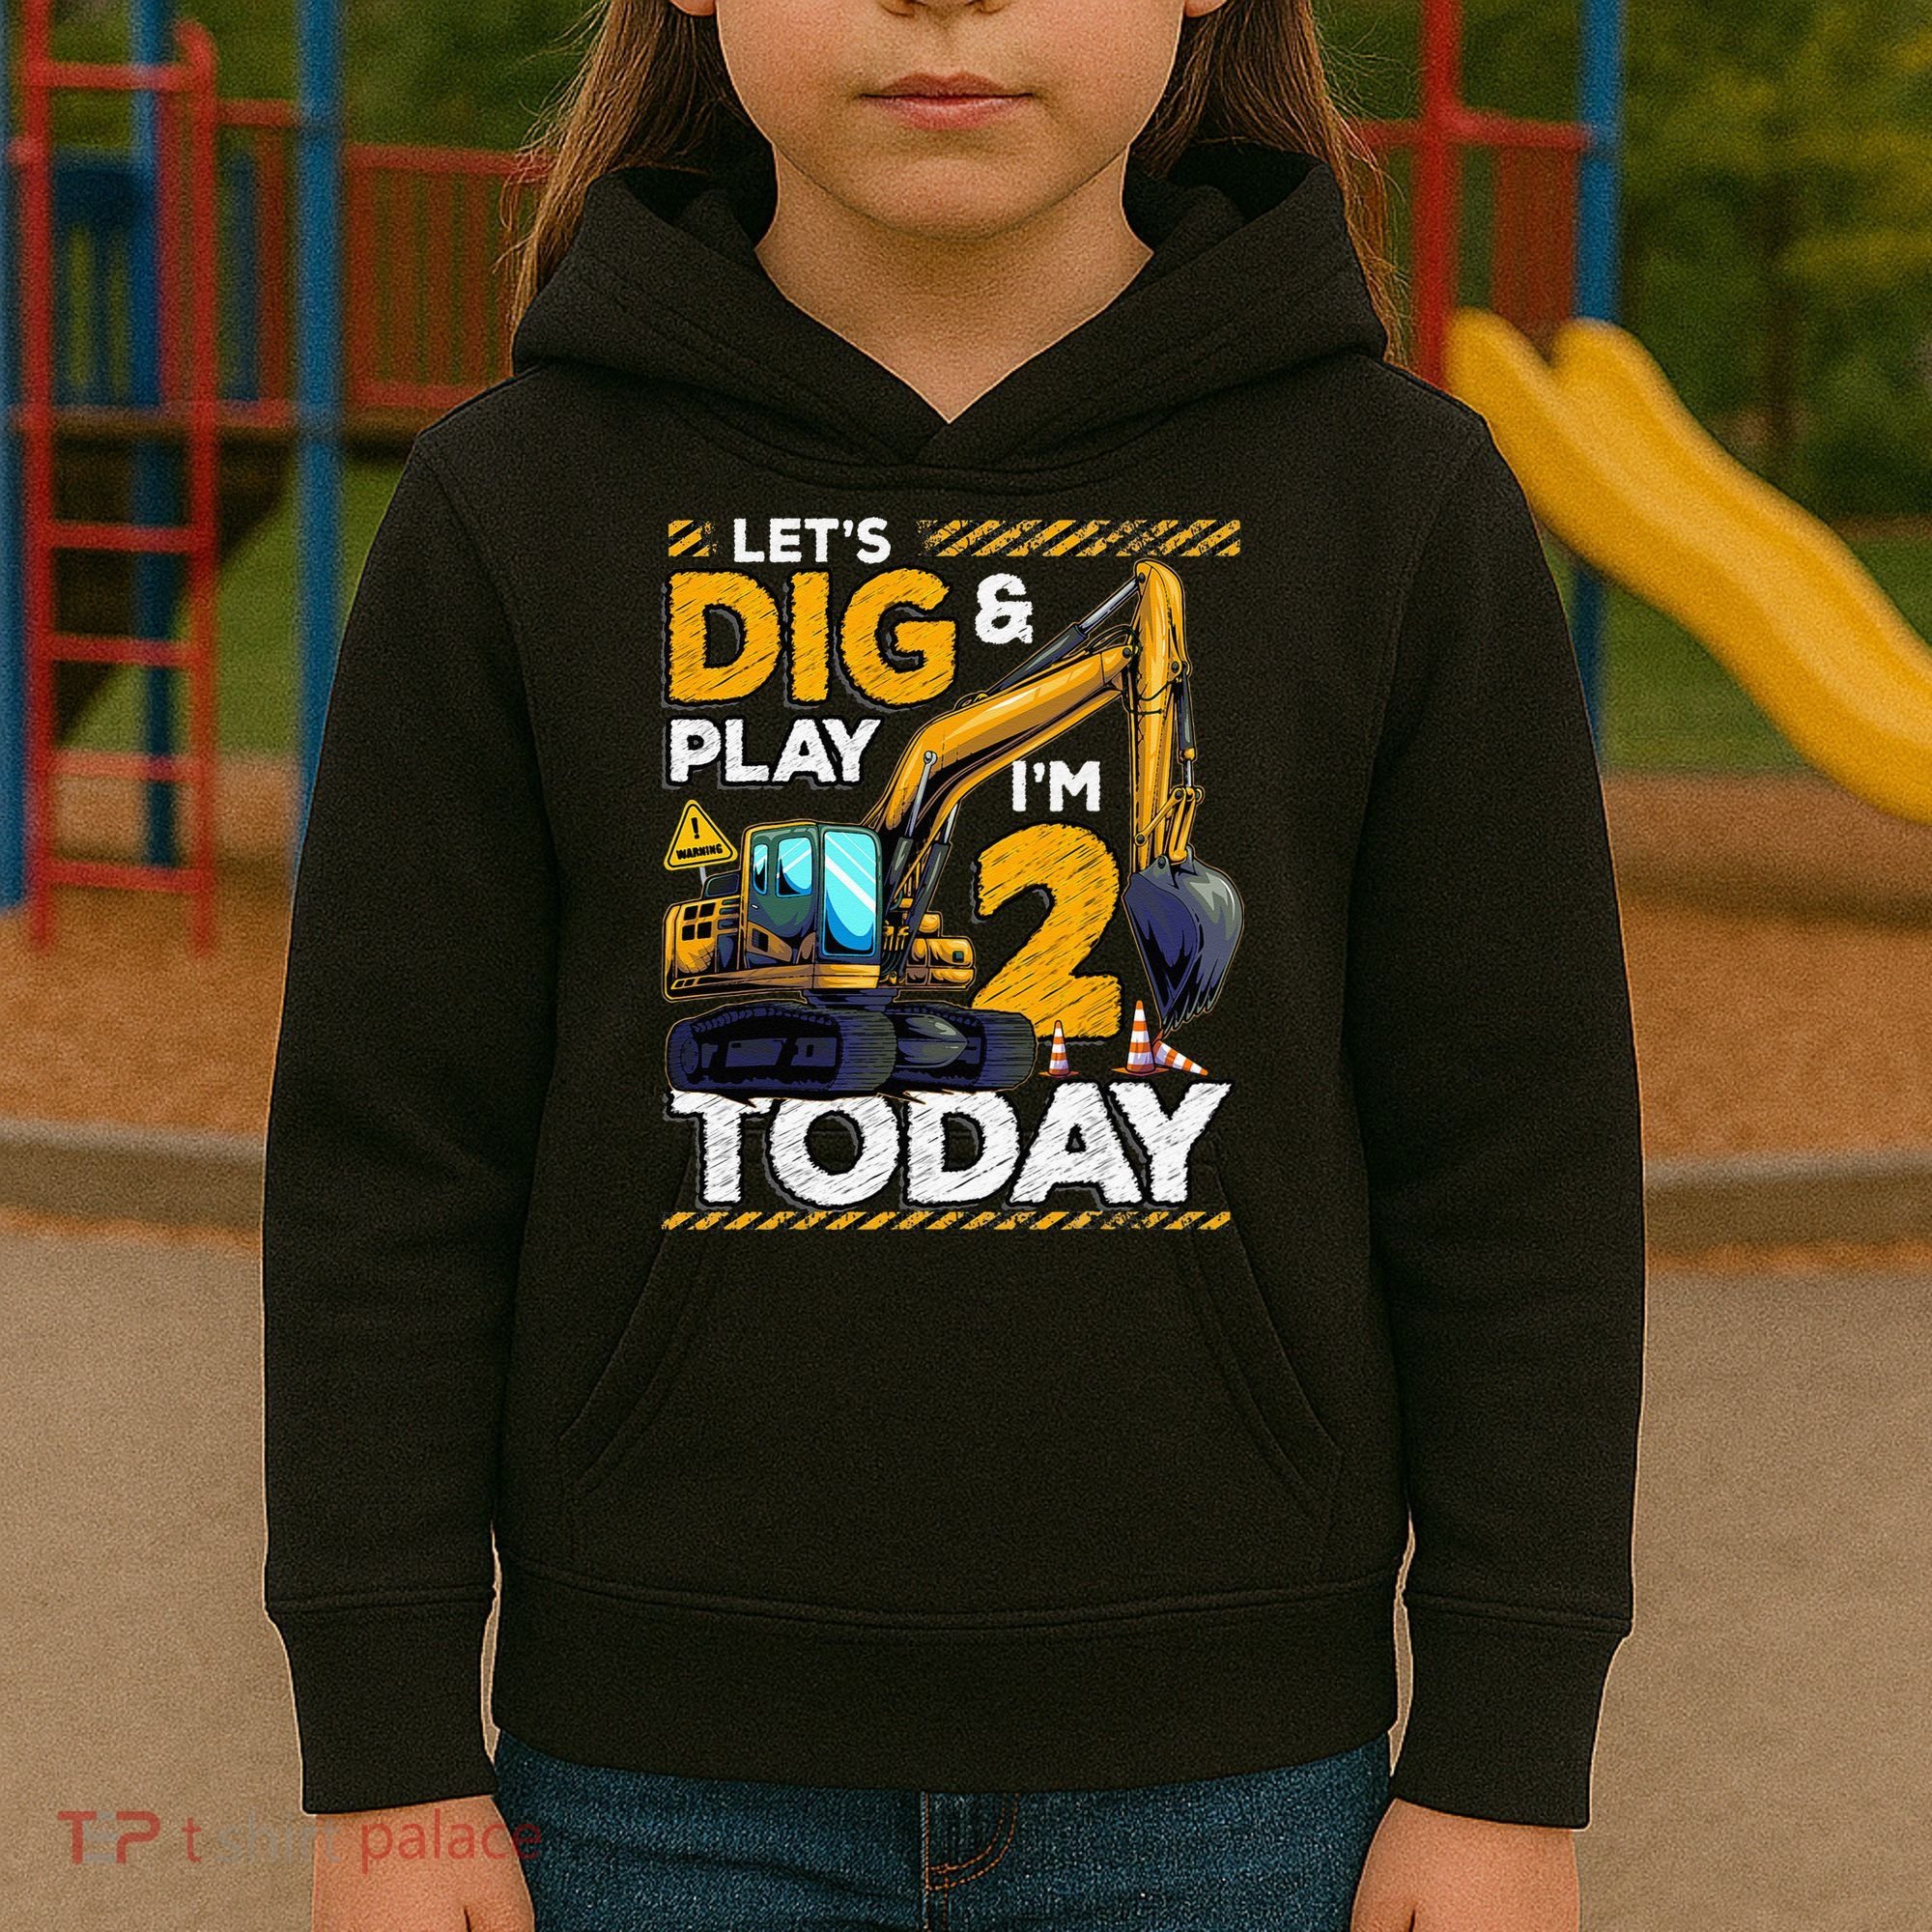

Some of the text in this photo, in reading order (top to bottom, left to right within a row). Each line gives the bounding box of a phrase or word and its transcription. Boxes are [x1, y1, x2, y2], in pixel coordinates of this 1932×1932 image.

[733, 517, 891, 563] LET'S
[668, 568, 1034, 705] DIG &
[668, 719, 881, 783] PLAY
[1011, 760, 1101, 812] I'M
[676, 843, 724, 860] WARNING
[970, 823, 1122, 1041] 2
[668, 1082, 1233, 1207] TODAY
